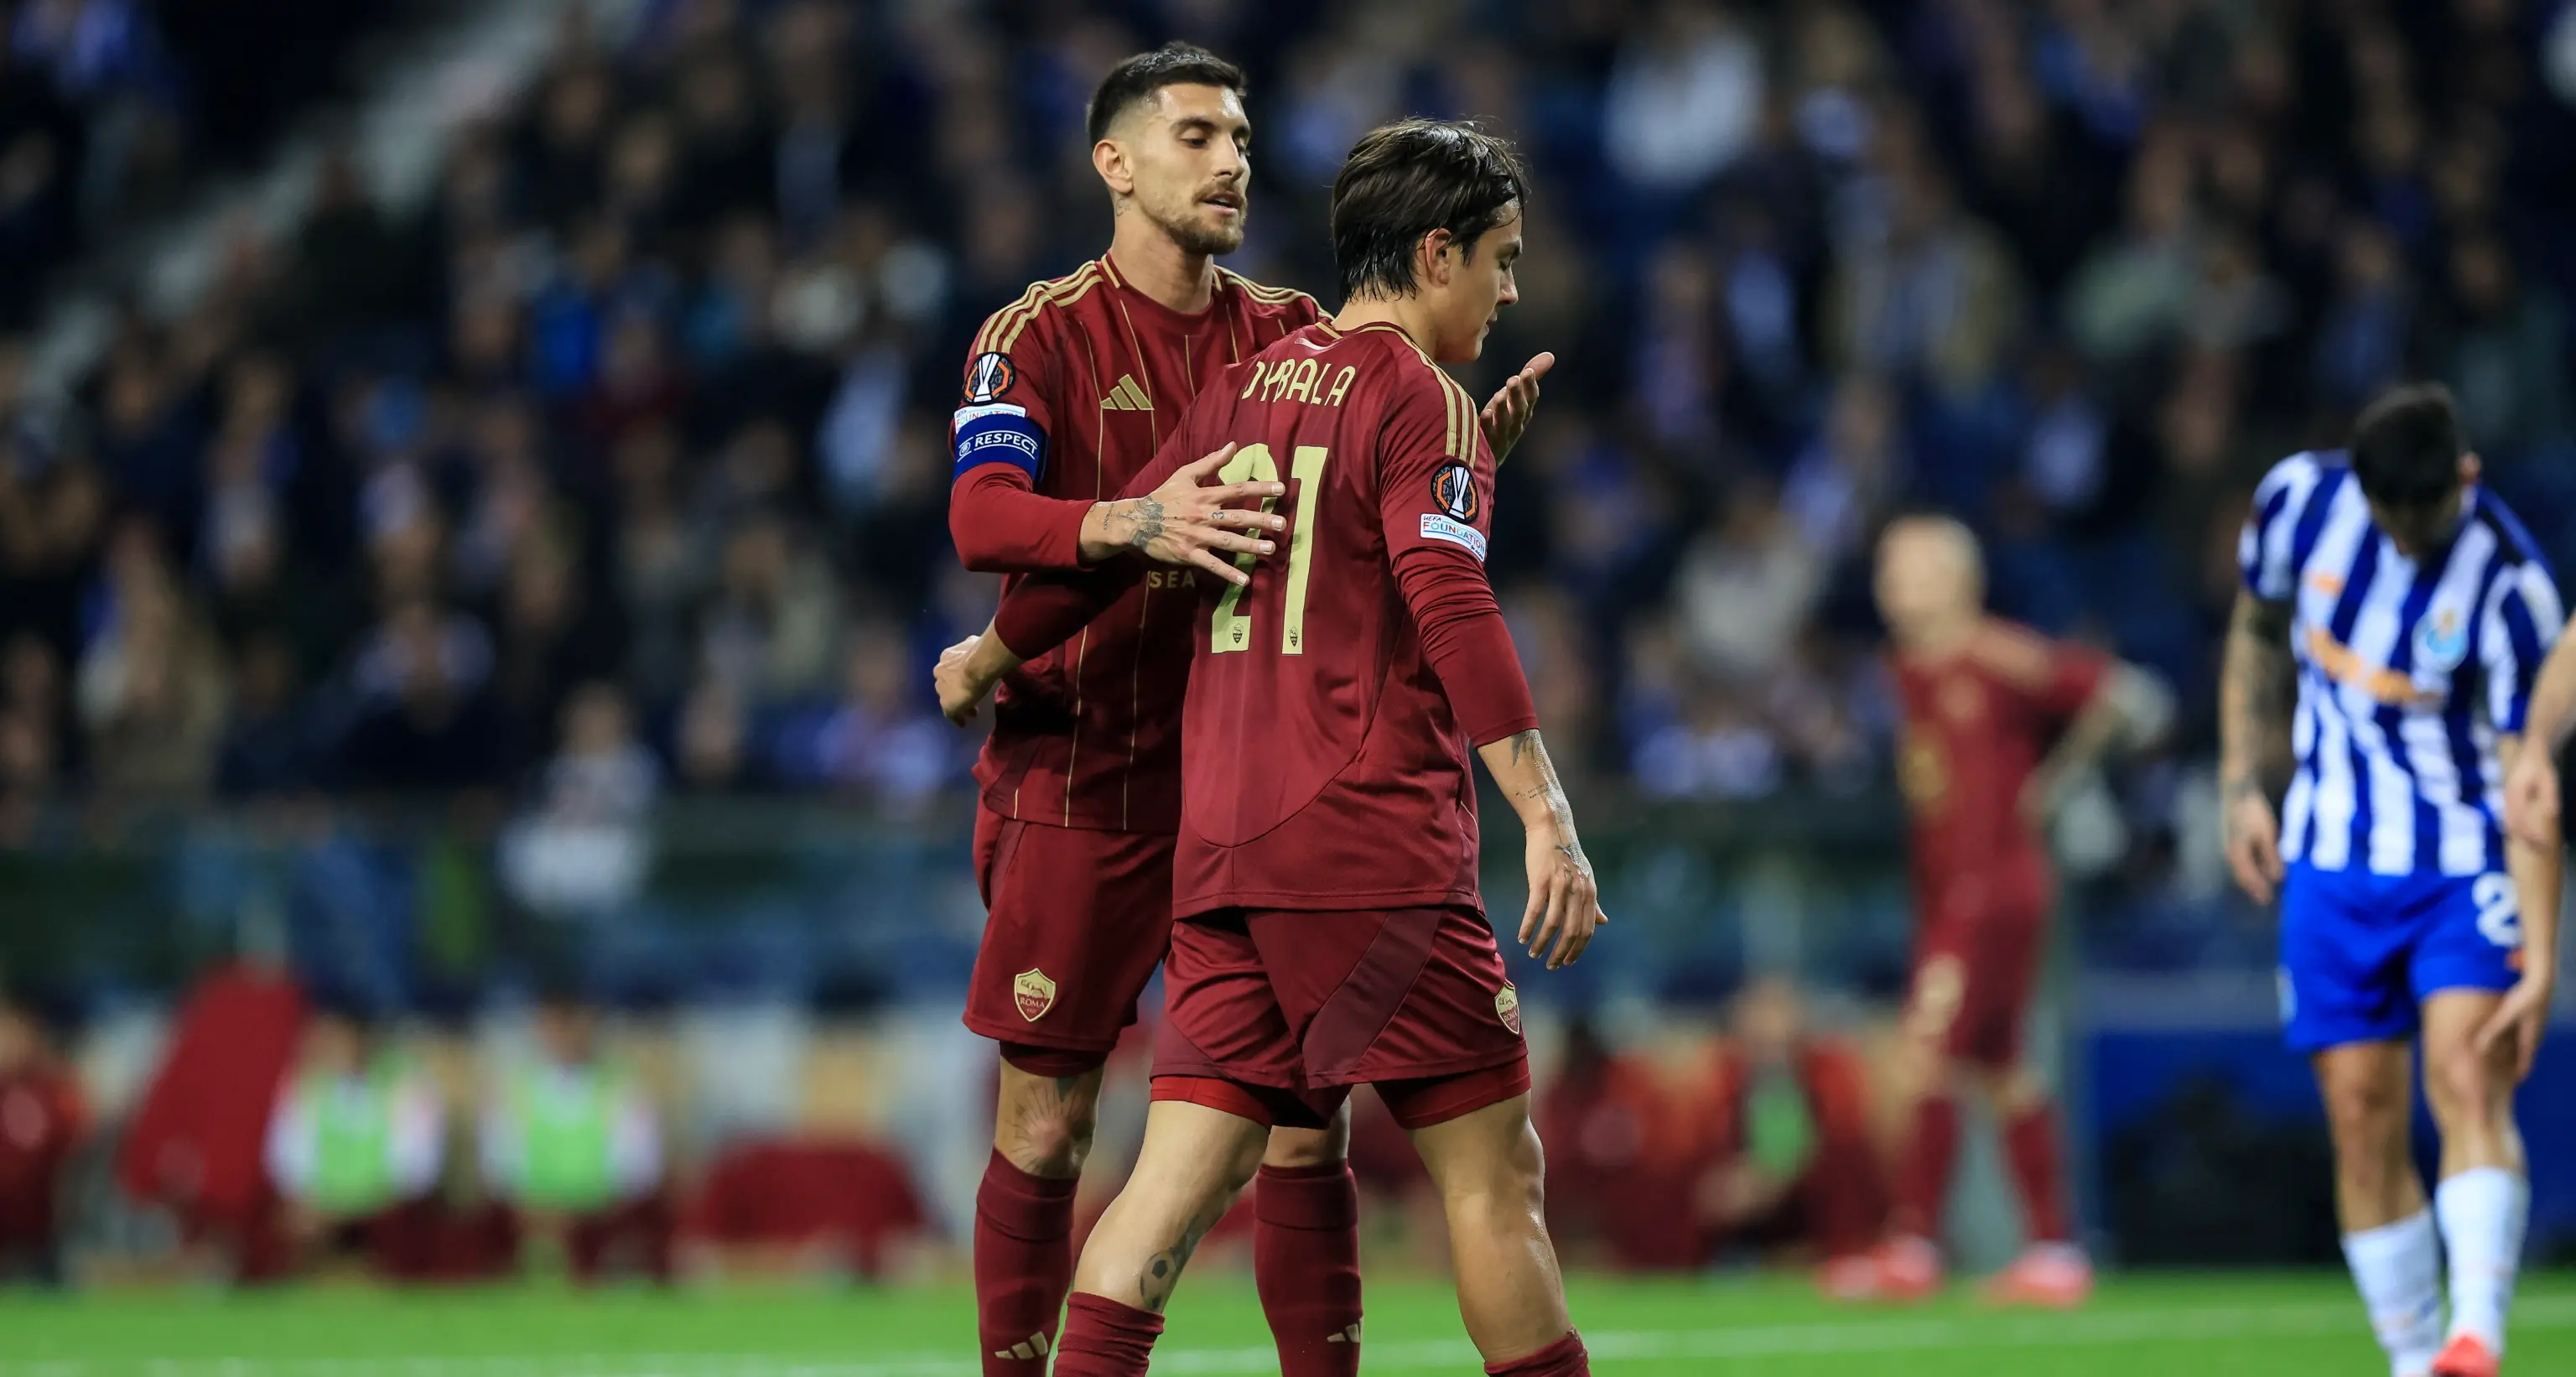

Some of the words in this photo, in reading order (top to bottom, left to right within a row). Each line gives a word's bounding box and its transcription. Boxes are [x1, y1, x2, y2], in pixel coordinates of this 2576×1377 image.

[1242, 359, 1356, 407] DYBALA
[974, 433, 1038, 455] RESPECT
[1212, 443, 1328, 655] 21
[1422, 521, 1485, 553] FOUNDATION
[1020, 996, 1046, 1009] ROMA
[1504, 1010, 1519, 1022] ROMA
